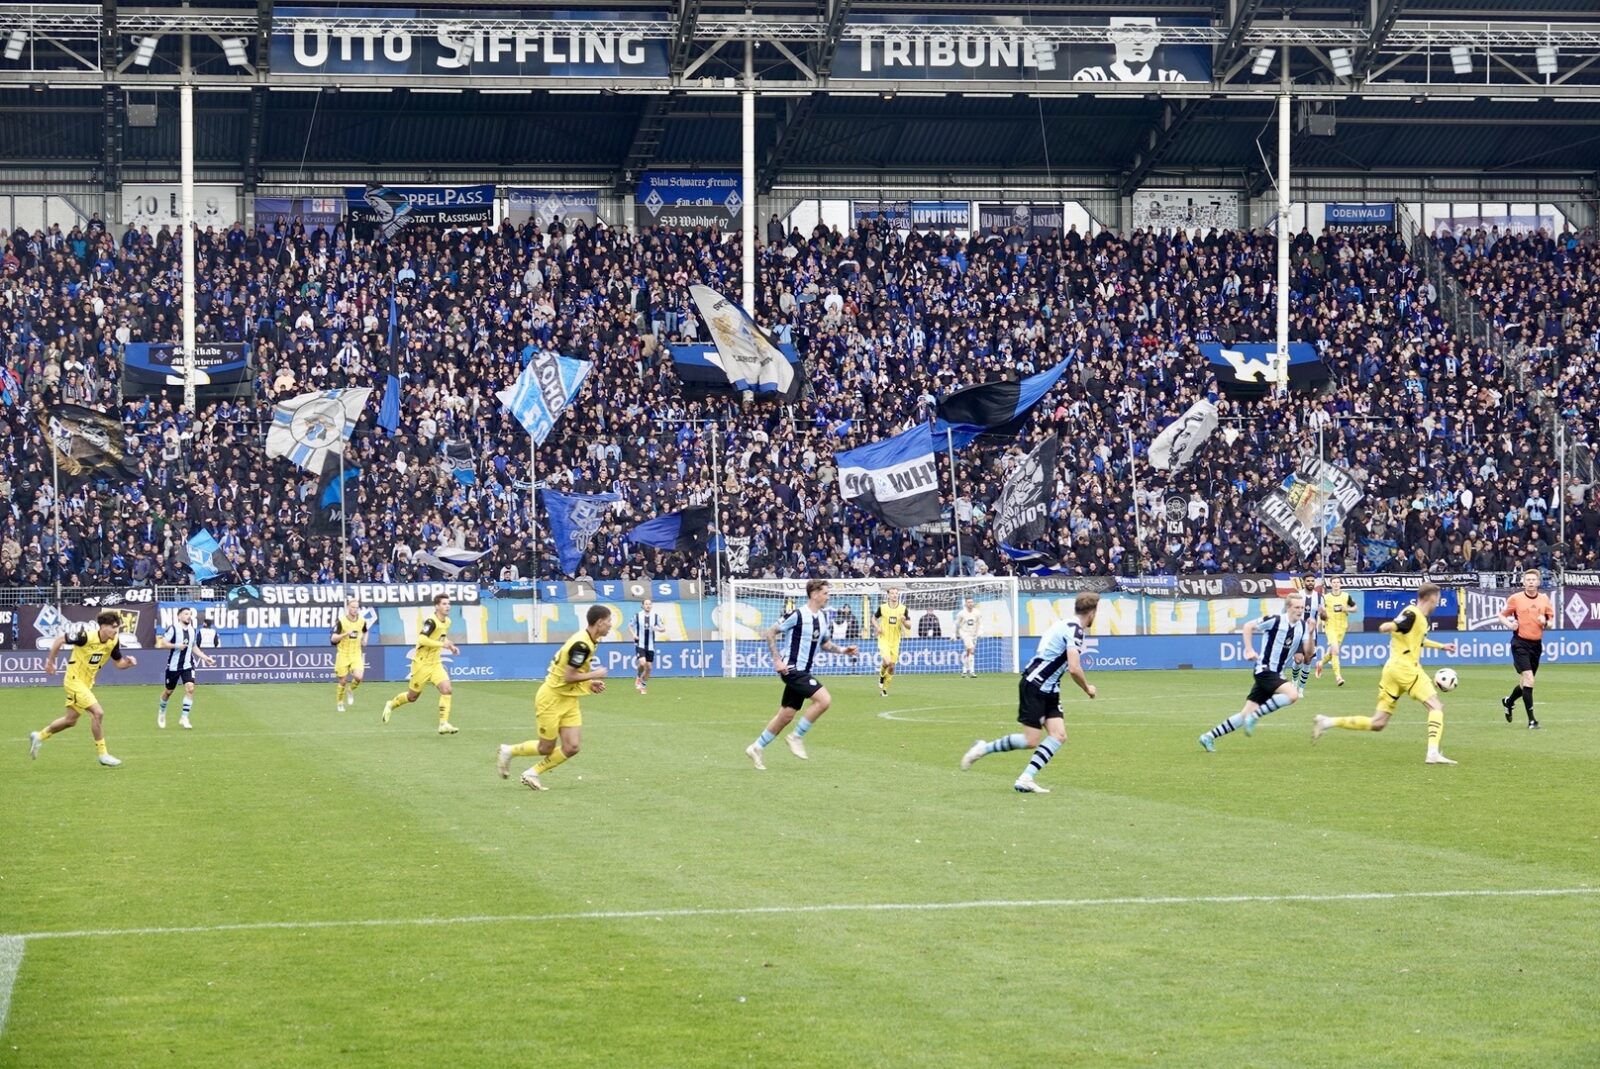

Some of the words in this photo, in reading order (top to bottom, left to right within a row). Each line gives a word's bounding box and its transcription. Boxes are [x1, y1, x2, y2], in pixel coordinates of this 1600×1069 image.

[293, 24, 412, 67] OTTO
[650, 177, 669, 187] Blau
[670, 177, 706, 188] Schwarze
[706, 177, 738, 188] Freunde
[562, 194, 597, 206] Crew
[695, 197, 713, 207] Club
[913, 209, 968, 224] KAPUTTICKS
[1332, 208, 1386, 218] ODENWALD
[660, 216, 677, 227] SV
[679, 215, 718, 227] Waldhof
[1373, 576, 1401, 588] SECHS
[1401, 577, 1424, 588] ACHT
[262, 586, 310, 604] SIEG
[312, 586, 345, 603] UM
[1376, 600, 1398, 609] HEY
[246, 607, 281, 629] DEN
[680, 650, 714, 669] für
[1096, 657, 1137, 666] LOCATEC
[450, 666, 494, 675] LOCATEC
